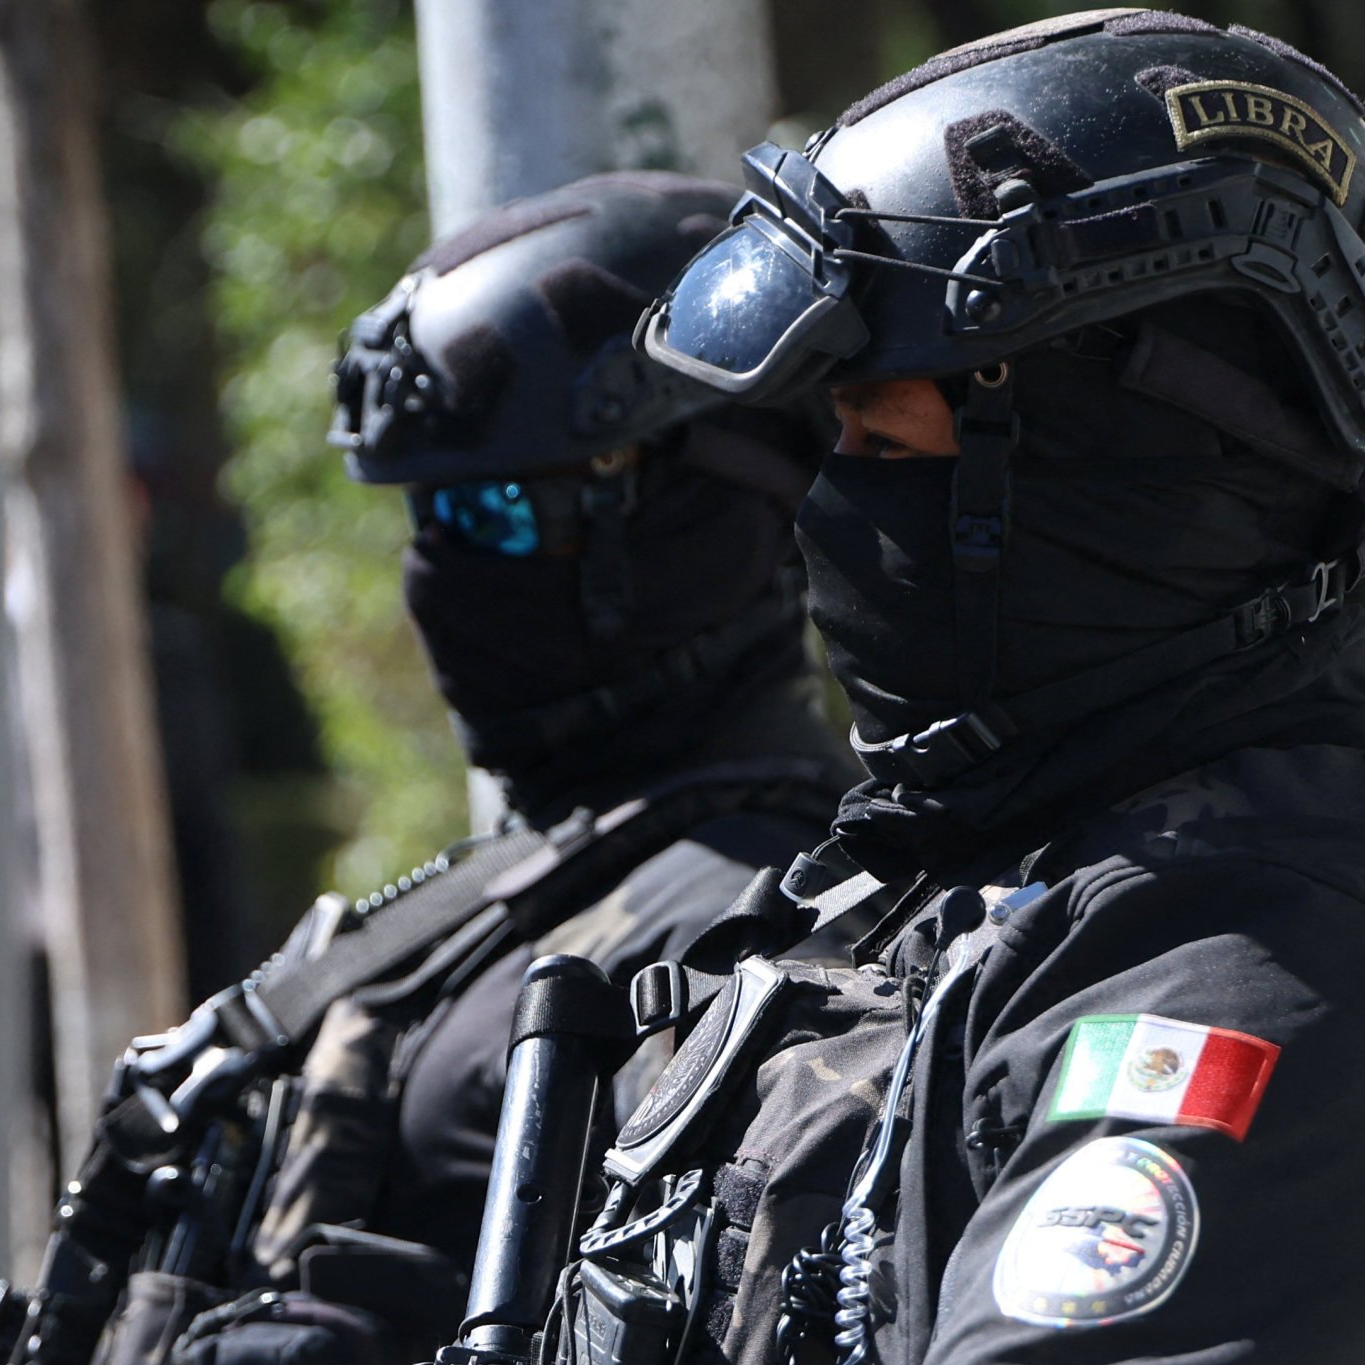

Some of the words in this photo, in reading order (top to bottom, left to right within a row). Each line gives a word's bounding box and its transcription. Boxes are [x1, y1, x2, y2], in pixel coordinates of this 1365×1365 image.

[1188, 91, 1335, 173] LIBRA
[1037, 1206, 1160, 1239] SSPC
[1124, 1241, 1184, 1304] CIUDADANA
